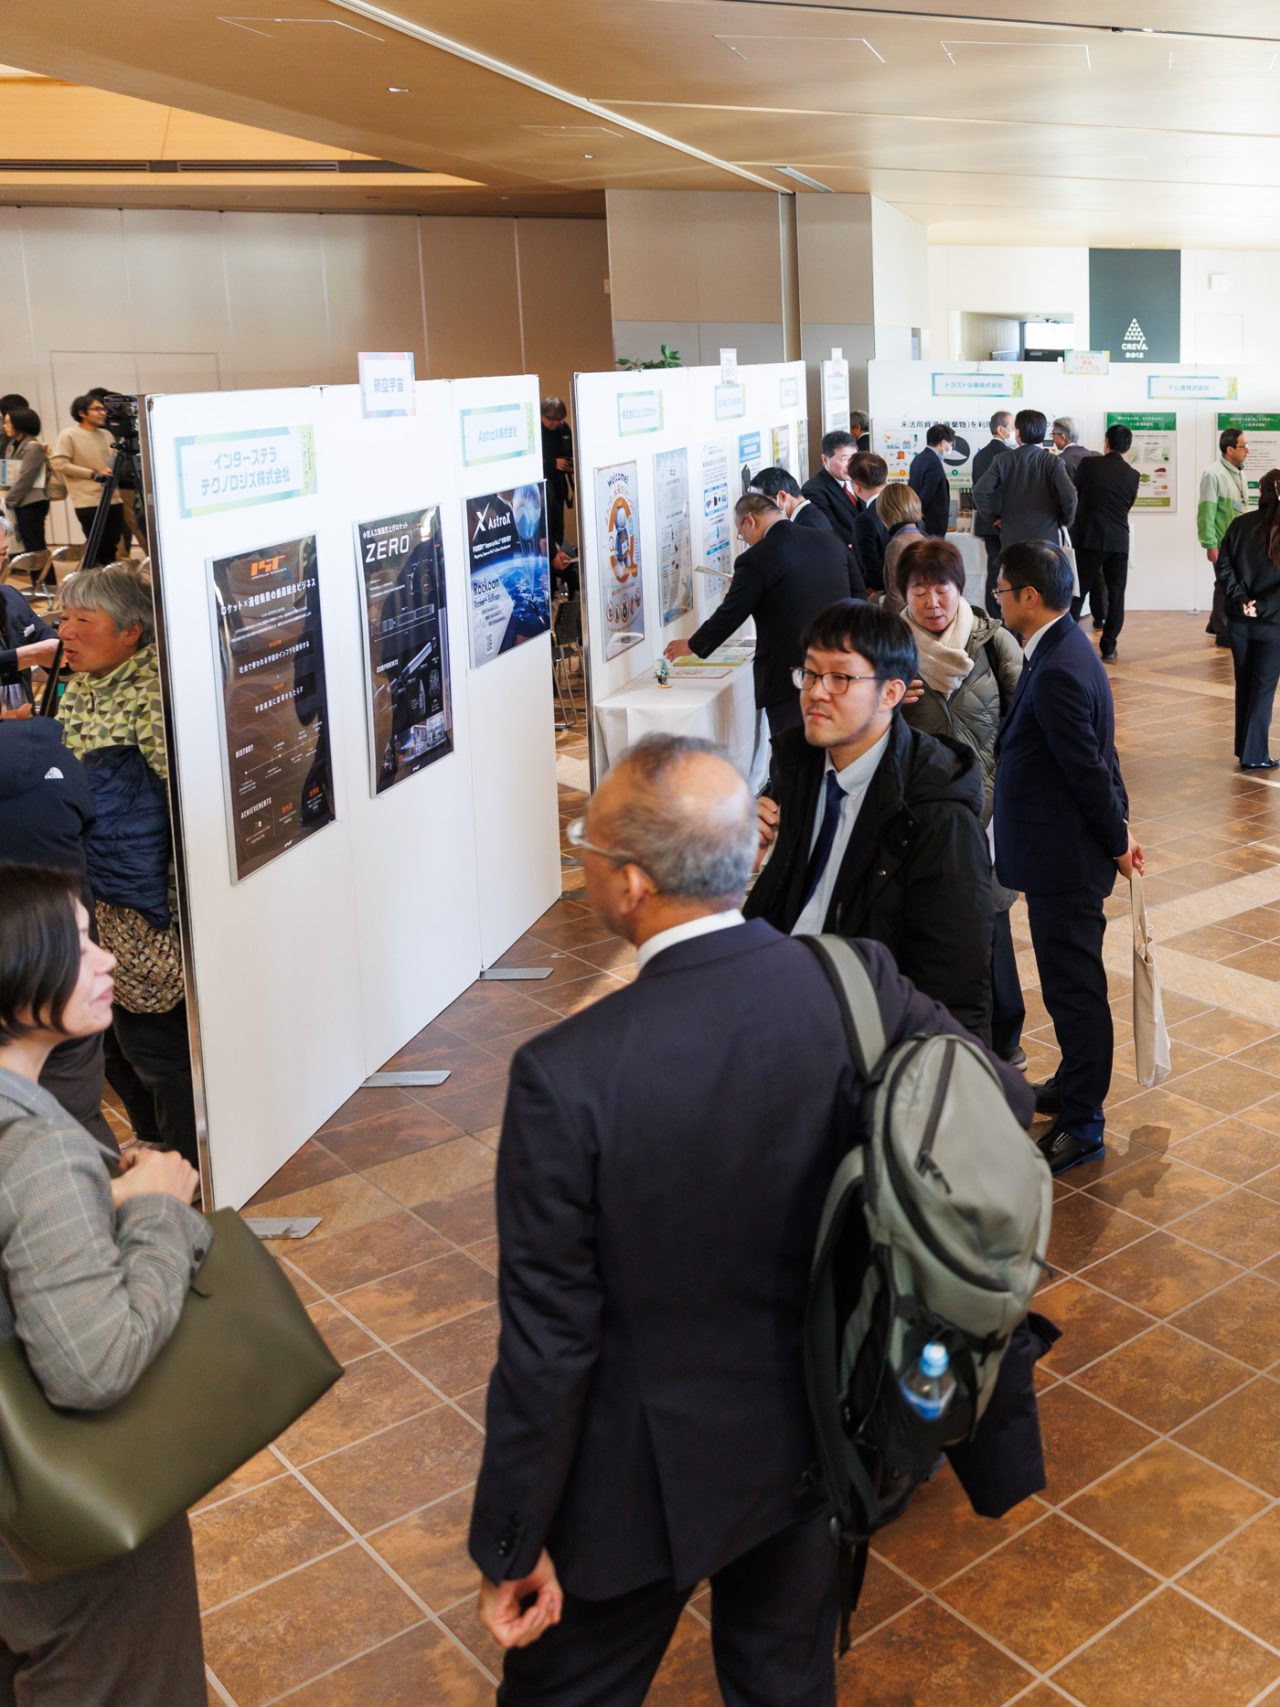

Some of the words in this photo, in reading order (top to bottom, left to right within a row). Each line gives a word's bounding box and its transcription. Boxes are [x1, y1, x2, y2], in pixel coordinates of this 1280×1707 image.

[1121, 341, 1149, 351] CREVA
[374, 377, 404, 393] 航空宇宙
[214, 446, 278, 470] インターステラ
[201, 466, 291, 496] テクノロジズ株式会社
[488, 512, 511, 530] AstroX
[365, 534, 410, 564] ZERO
[473, 578, 500, 597] Rockoon
